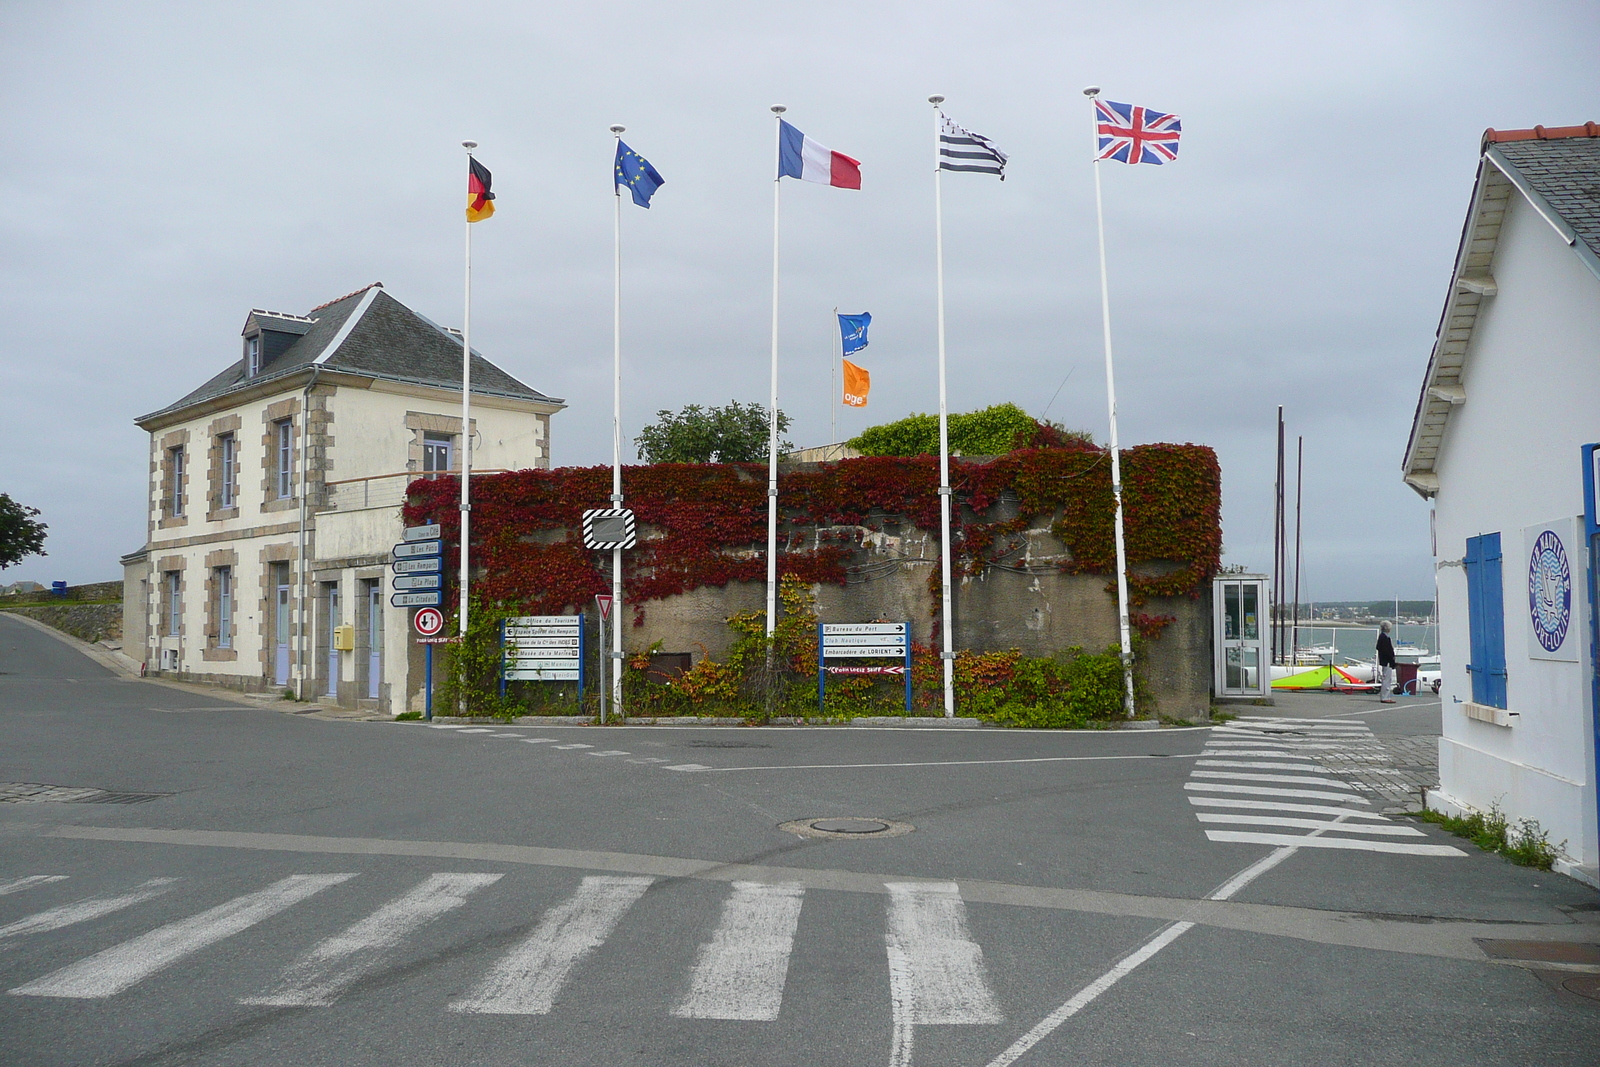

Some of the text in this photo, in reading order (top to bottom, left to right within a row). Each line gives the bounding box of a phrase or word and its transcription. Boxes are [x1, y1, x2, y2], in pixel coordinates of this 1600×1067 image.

[417, 562, 437, 570] Remparts
[1530, 532, 1570, 593] CLUB NAUTIQUE
[424, 578, 437, 586] Plage
[416, 595, 437, 603] Citadelle
